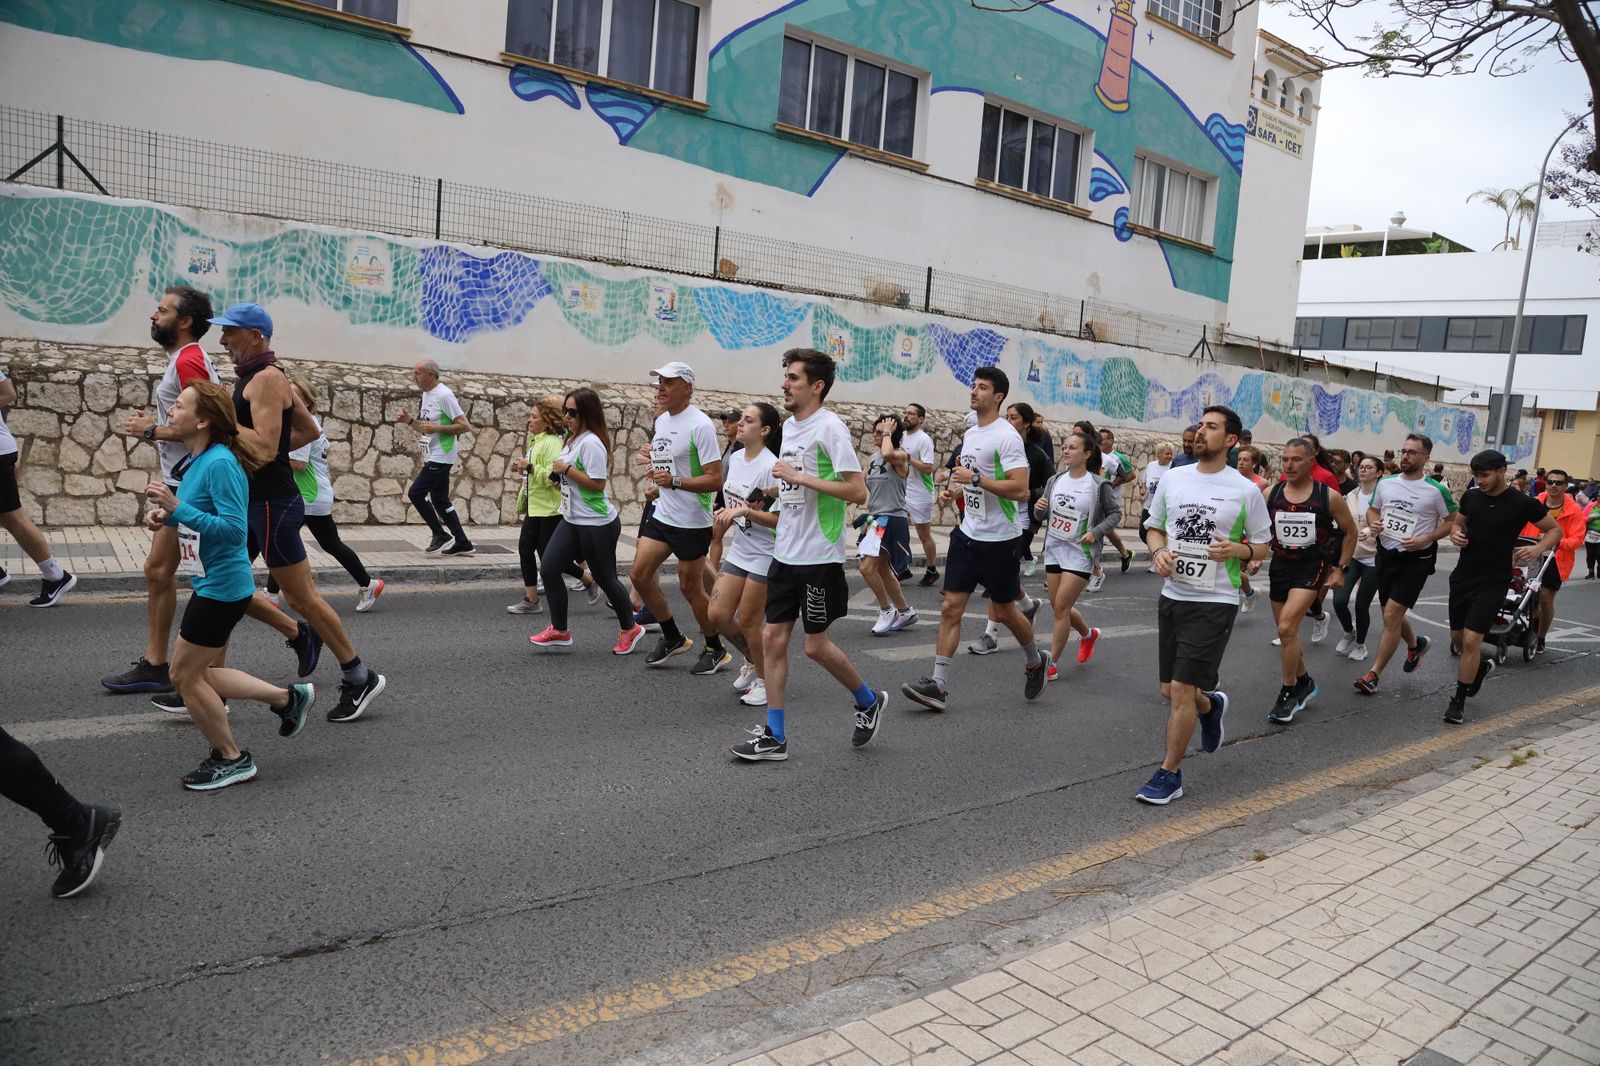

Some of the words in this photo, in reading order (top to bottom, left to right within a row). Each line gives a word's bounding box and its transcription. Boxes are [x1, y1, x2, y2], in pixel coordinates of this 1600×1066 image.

[1258, 127, 1277, 145] SAFA
[1285, 140, 1302, 155] ICET
[1051, 517, 1072, 532] 278
[1283, 526, 1309, 538] 923
[1386, 519, 1409, 534] 534
[1175, 559, 1208, 578] 867
[806, 584, 827, 623] NIKE
